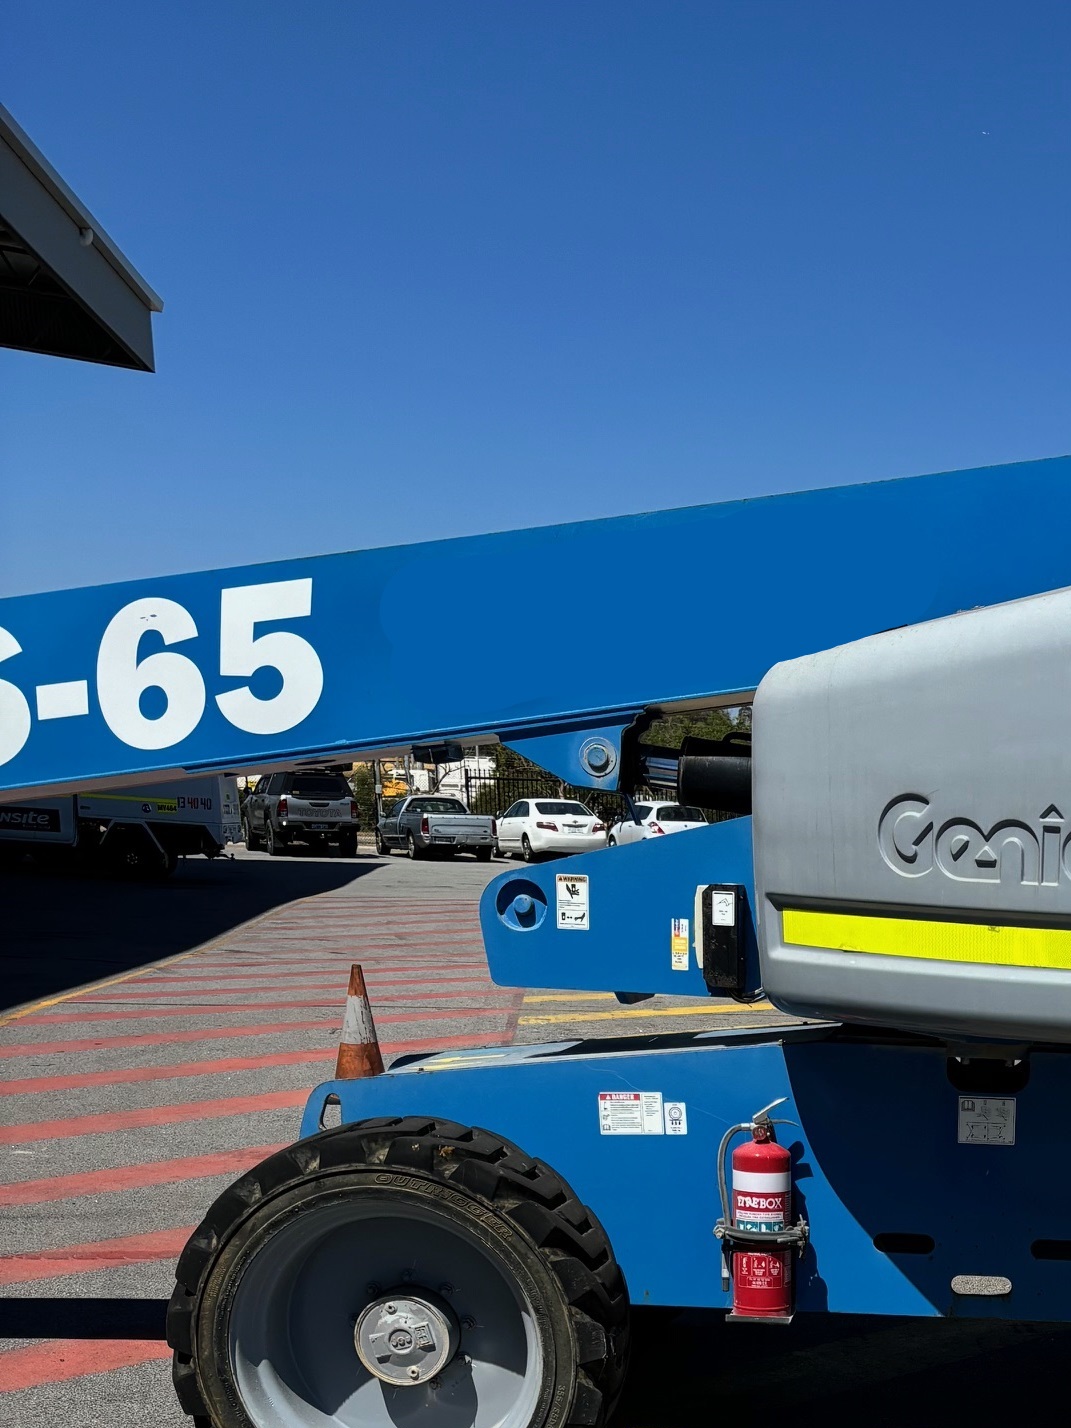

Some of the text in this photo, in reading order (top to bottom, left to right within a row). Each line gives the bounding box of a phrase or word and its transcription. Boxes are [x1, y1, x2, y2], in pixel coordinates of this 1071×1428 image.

[187, 797, 199, 809] 40
[200, 798, 212, 810] 40
[298, 808, 342, 818] TOYOTA
[374, 1173, 512, 1241] OUTRIGGER
[737, 1196, 782, 1209] FIREBOX
